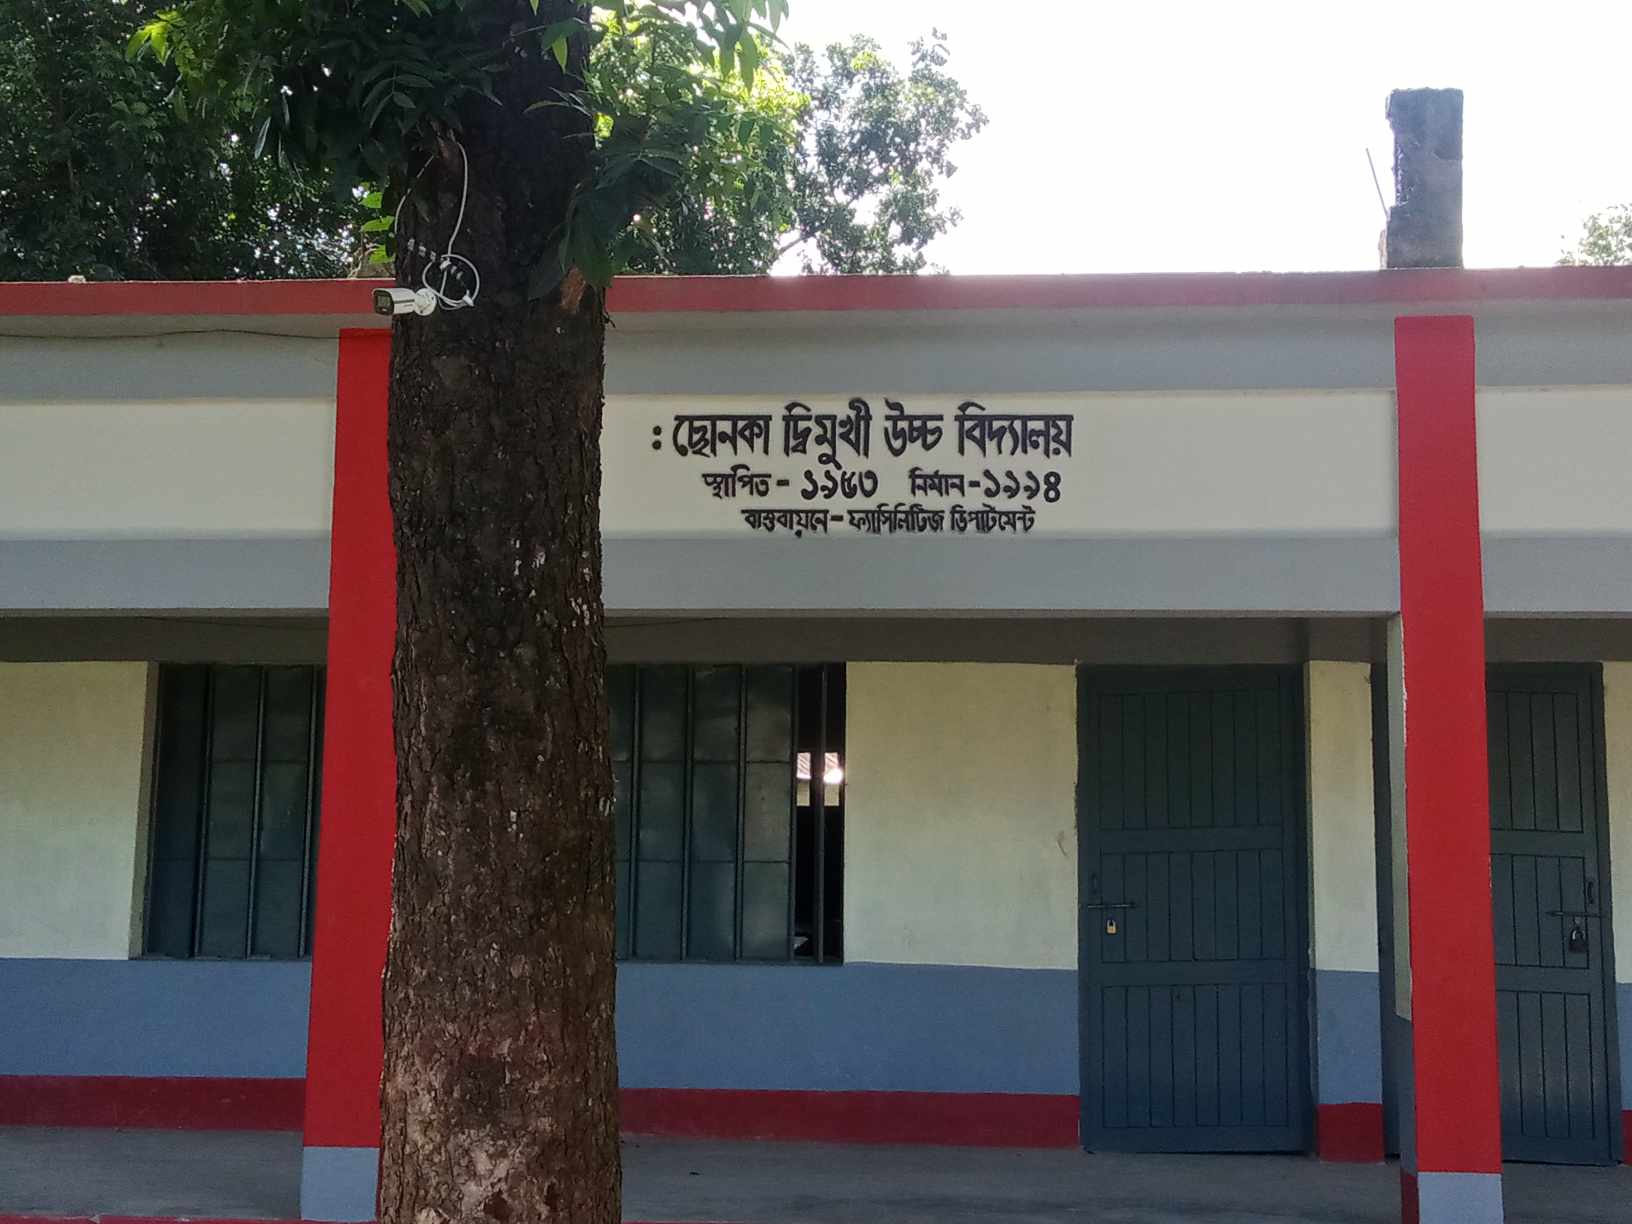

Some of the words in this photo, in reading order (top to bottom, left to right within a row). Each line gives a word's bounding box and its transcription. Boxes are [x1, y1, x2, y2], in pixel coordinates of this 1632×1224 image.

[672, 414, 772, 457] ছোনকা
[782, 397, 873, 470] দ্বিমুখী
[884, 397, 944, 457] উচ্চ
[954, 401, 1074, 458] বিদ্যালয়
